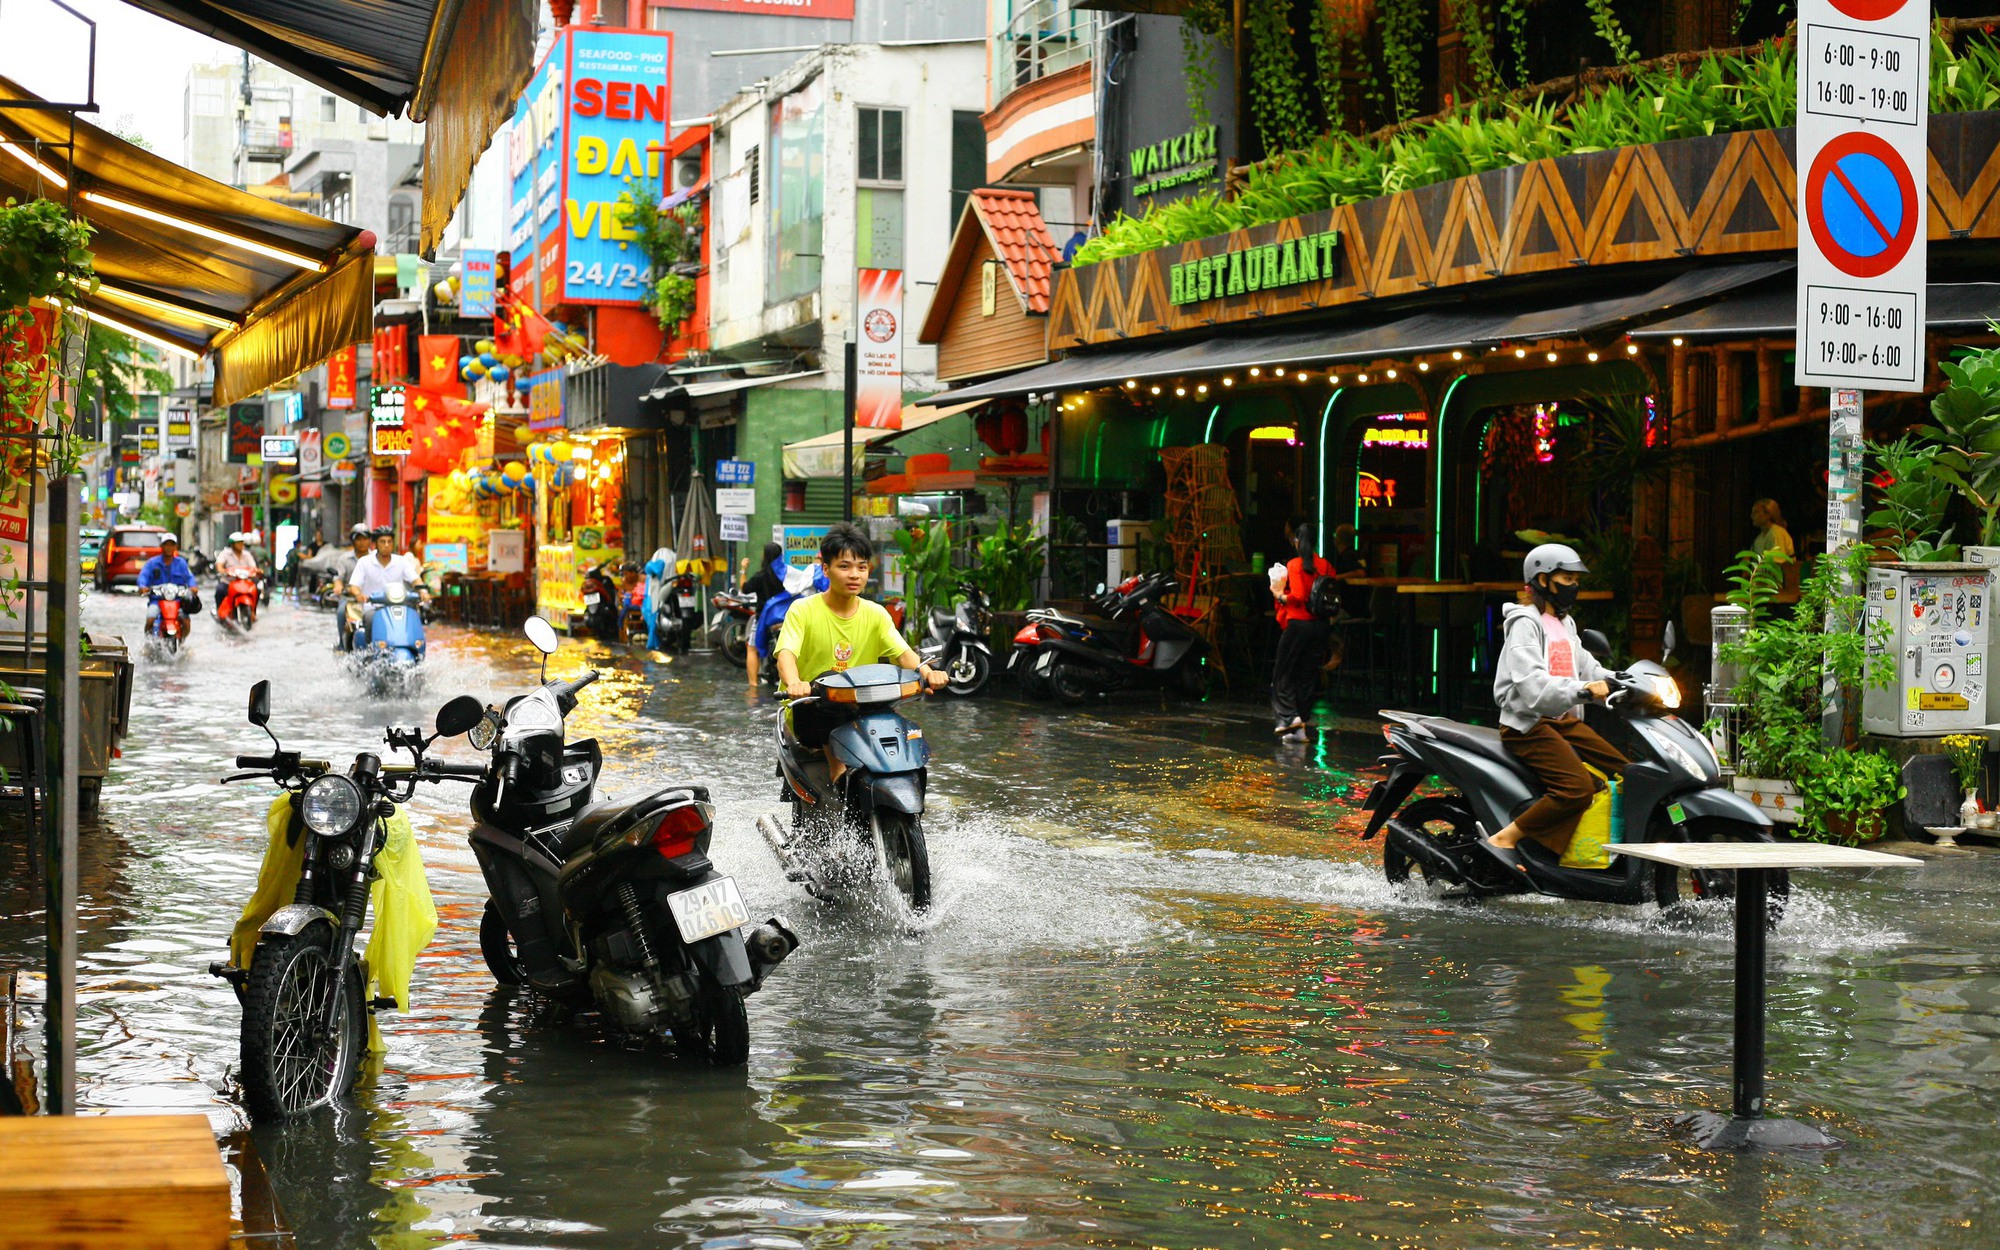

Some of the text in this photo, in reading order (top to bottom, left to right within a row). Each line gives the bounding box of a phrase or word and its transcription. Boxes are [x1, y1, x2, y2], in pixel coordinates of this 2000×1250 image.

[578, 49, 632, 61] SEAFOOD
[578, 61, 638, 73] RESTAURANT
[1824, 43, 1854, 68] 6:00
[1871, 48, 1900, 72] 9:00
[573, 77, 665, 122] SEN
[1817, 81, 1854, 105] 16:00
[1871, 87, 1907, 112] 19:00
[574, 136, 660, 184] ĐẠI
[1130, 125, 1217, 178] WAIKIKI
[1133, 184, 1149, 197] BAR
[1159, 165, 1216, 191] RESTAURANT
[565, 192, 667, 250] VIỆ
[467, 261, 490, 271] SEN
[1170, 230, 1338, 307] RESTAURANT
[1820, 302, 1849, 326] 9:00
[1866, 306, 1901, 330] 16:00
[1820, 341, 1856, 364] 19:00
[1872, 344, 1900, 367] 6:00
[265, 440, 295, 452] GS25
[0, 518, 20, 534] 7.90
[682, 902, 746, 939] 046.09
